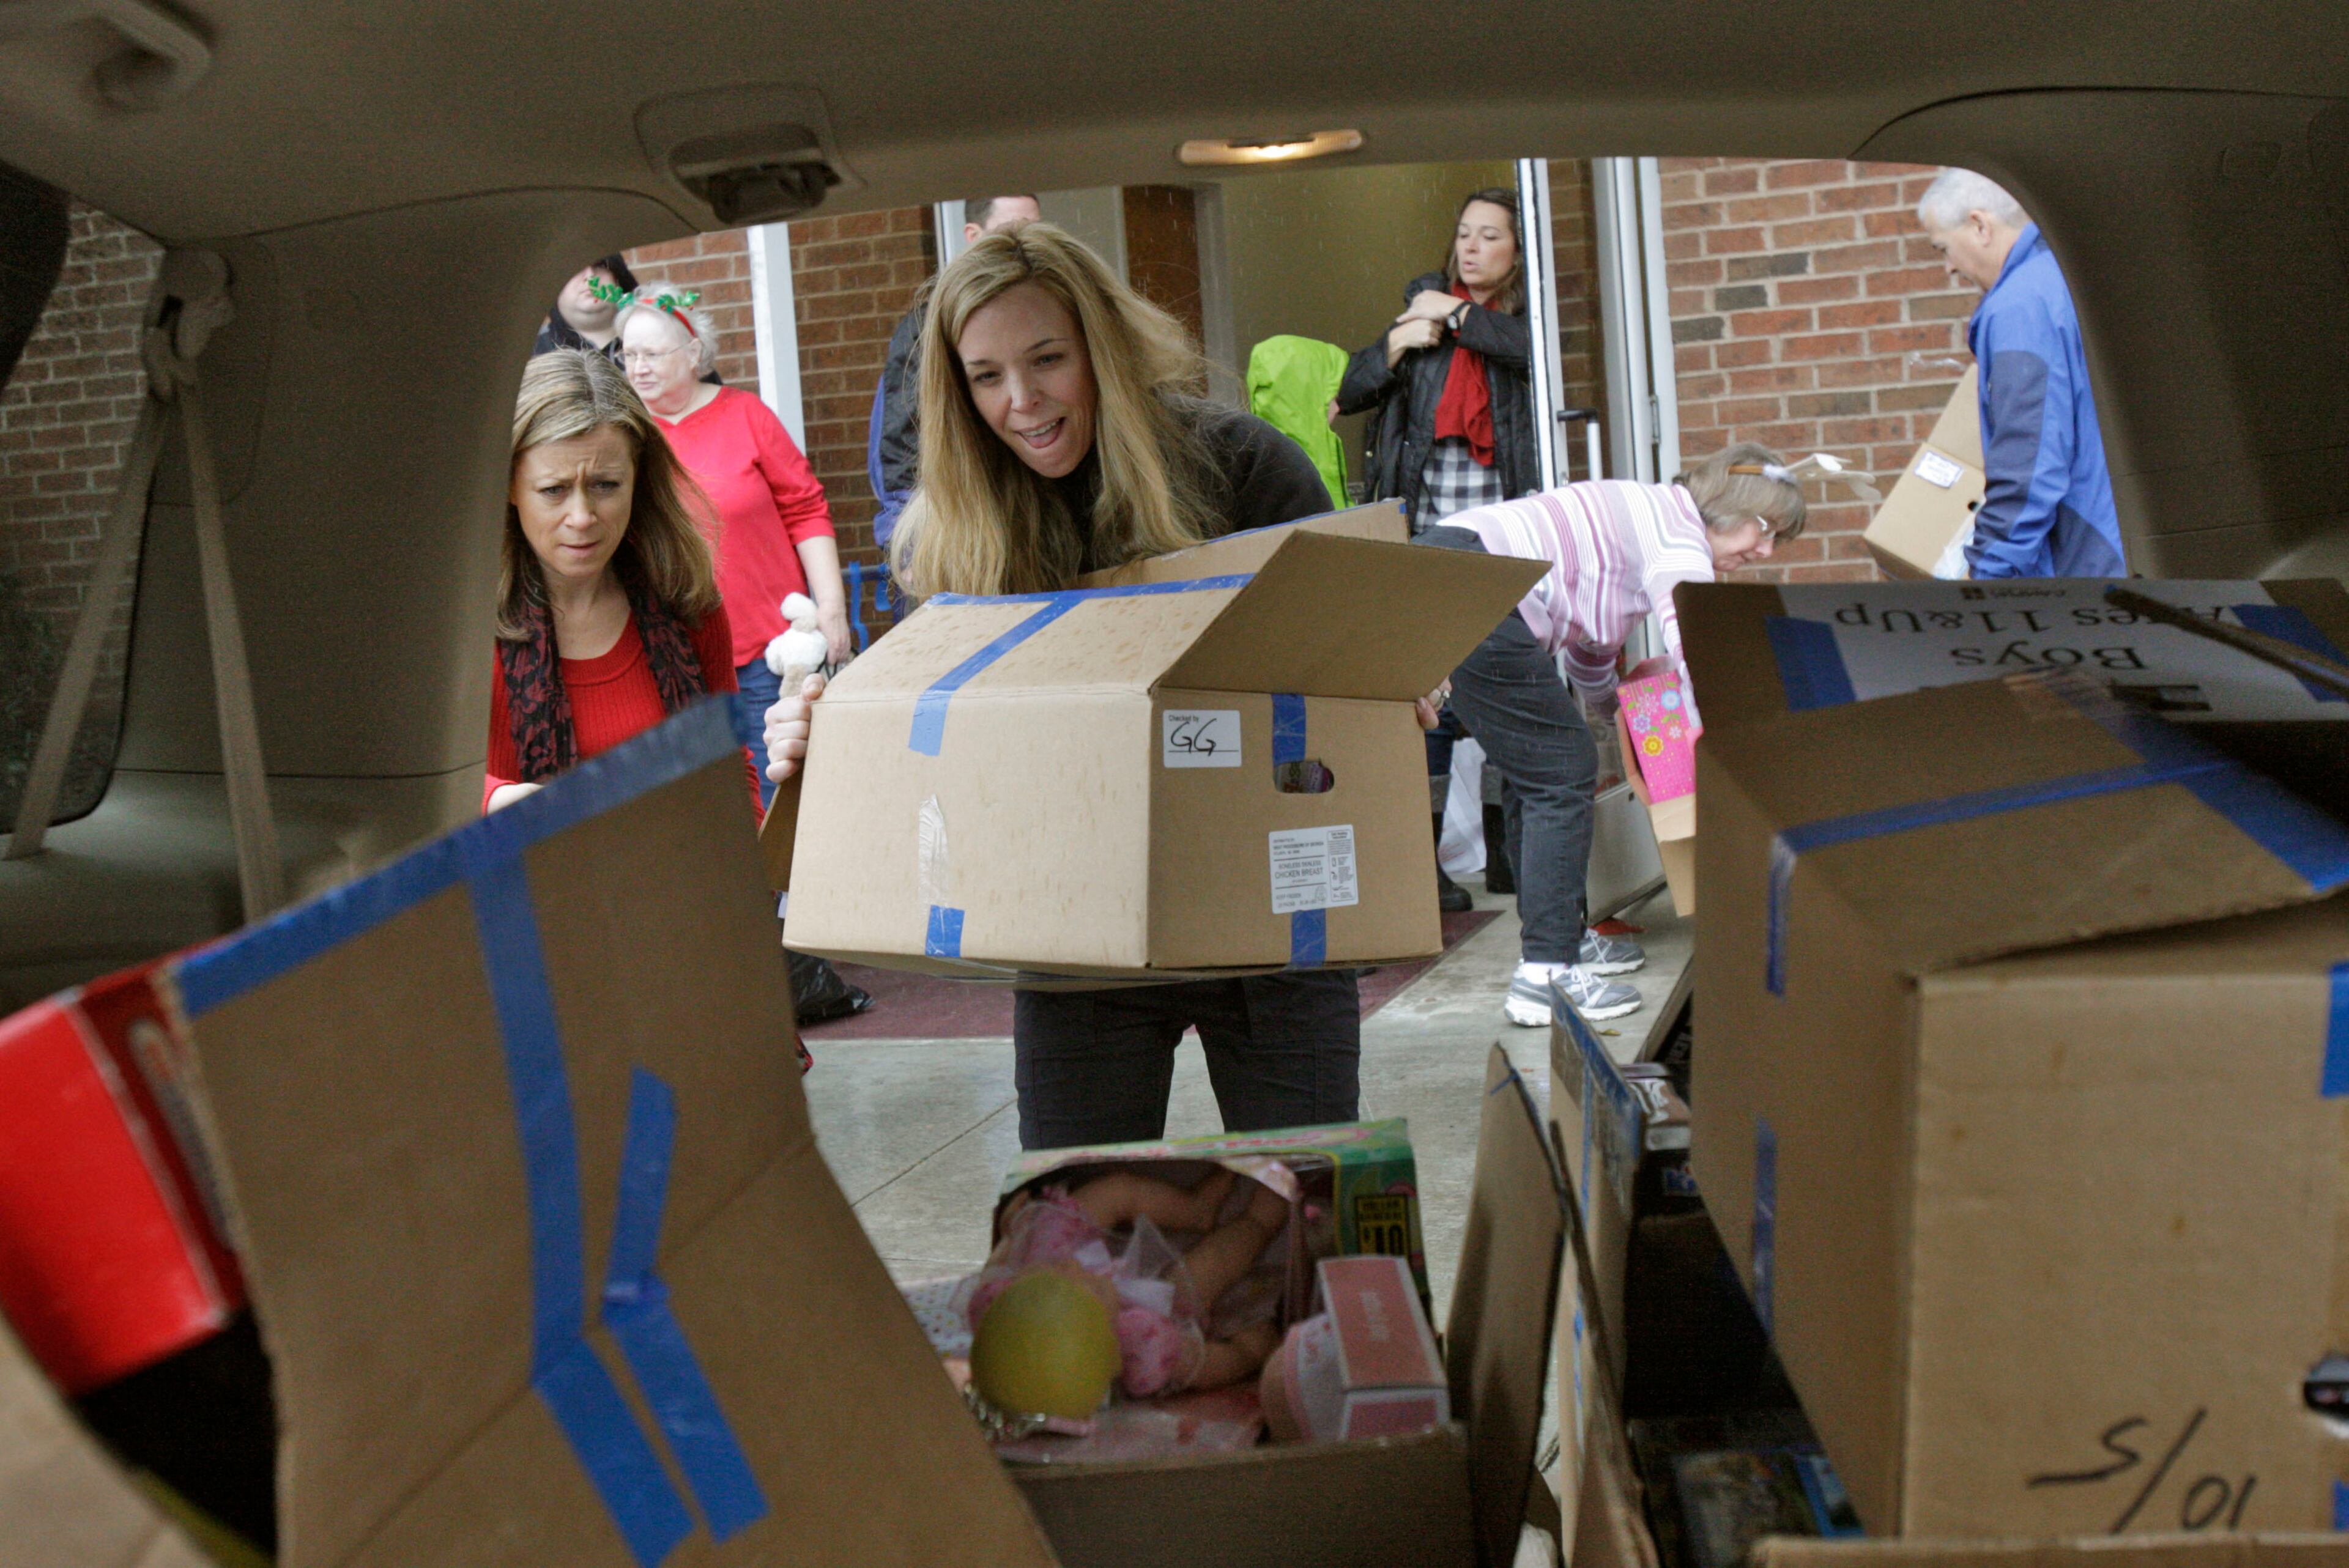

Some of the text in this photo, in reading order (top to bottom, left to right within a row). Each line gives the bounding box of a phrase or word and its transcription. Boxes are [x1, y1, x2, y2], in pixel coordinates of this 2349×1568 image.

[1950, 640, 2148, 670] Boys
[1275, 867, 1323, 879] CHICKEN BREAST
